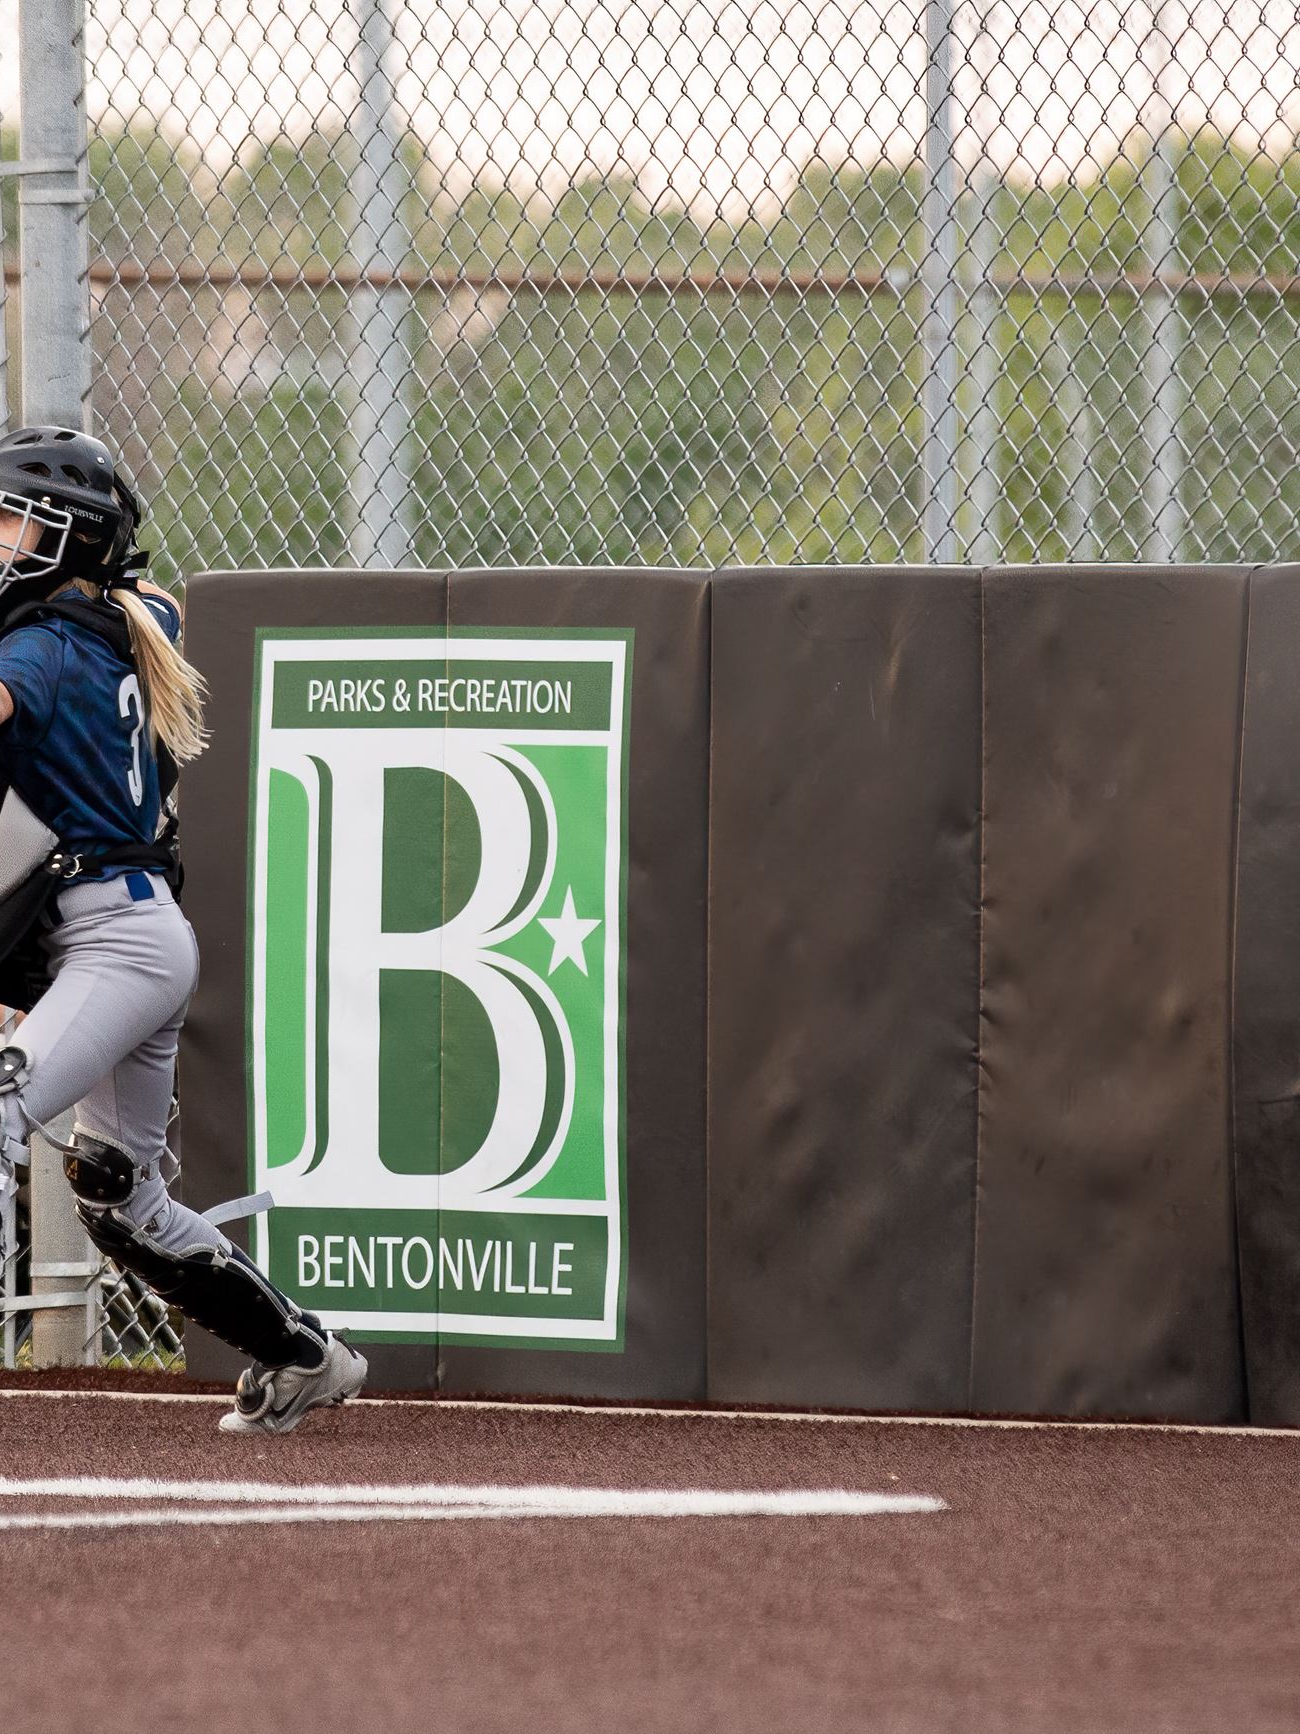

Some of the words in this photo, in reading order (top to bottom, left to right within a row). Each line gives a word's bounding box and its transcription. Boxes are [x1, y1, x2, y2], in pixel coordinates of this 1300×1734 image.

[308, 679, 386, 712] PARKS
[392, 679, 411, 712] &
[418, 679, 572, 714] RECREATION
[285, 745, 574, 1198] B
[298, 1235, 575, 1296] BENTONVILLE
